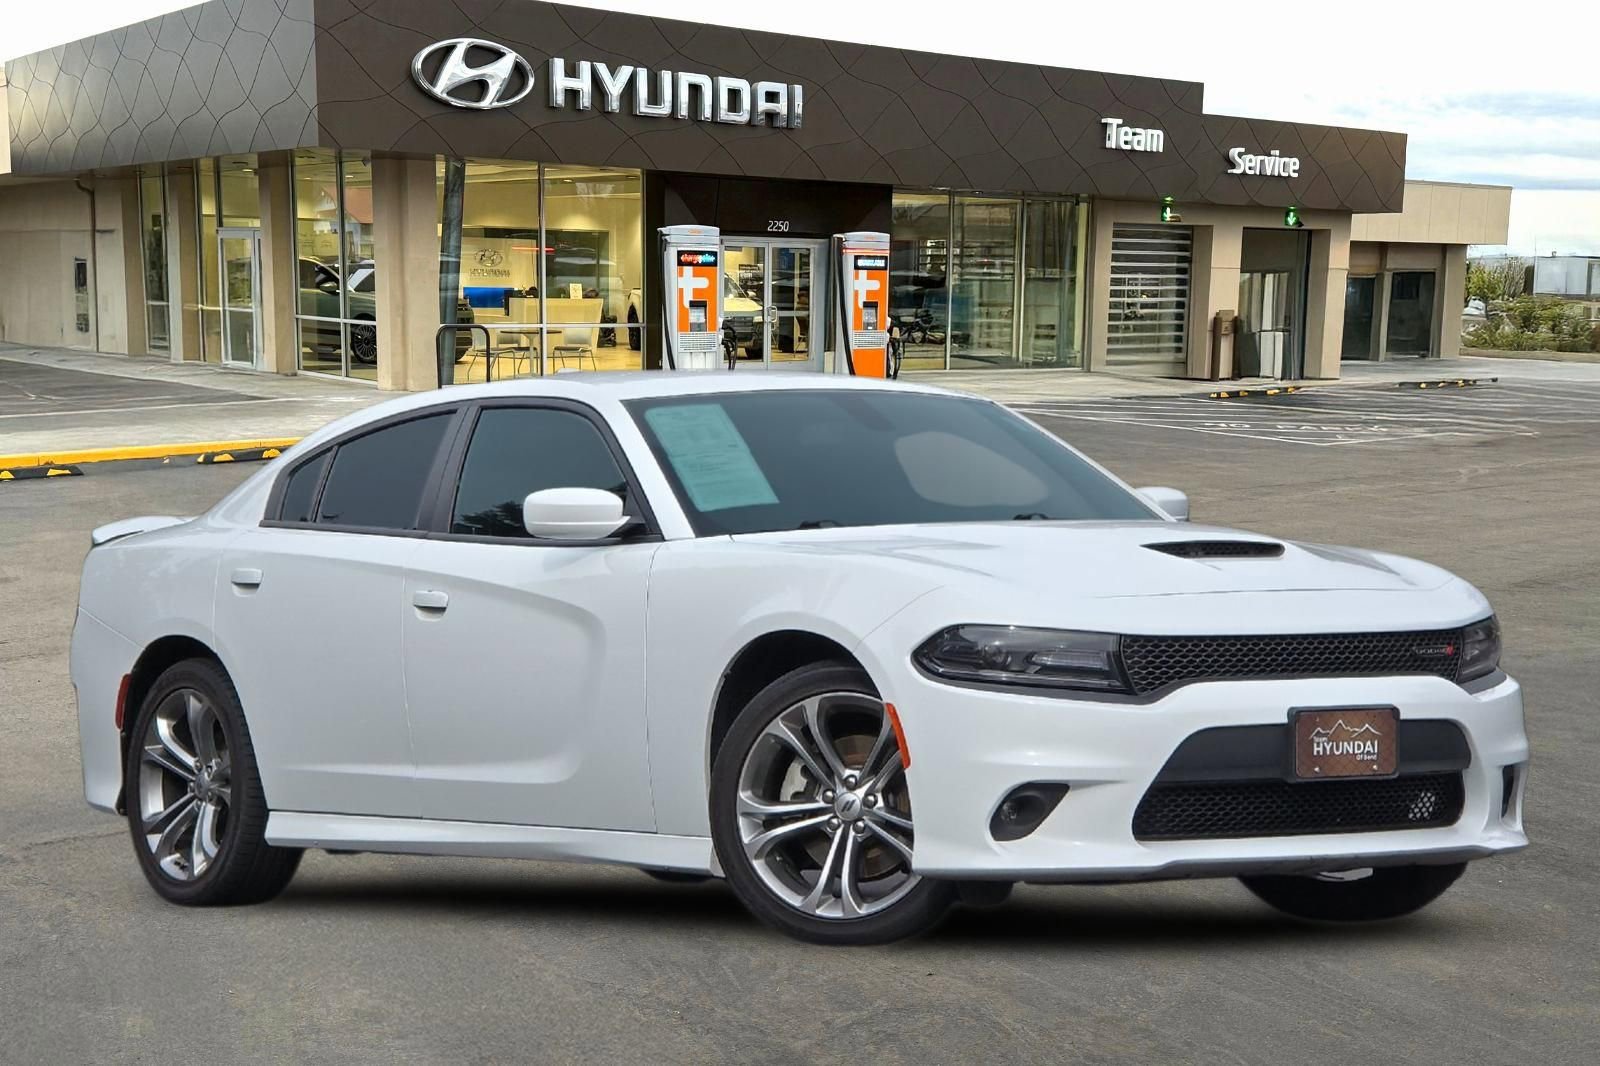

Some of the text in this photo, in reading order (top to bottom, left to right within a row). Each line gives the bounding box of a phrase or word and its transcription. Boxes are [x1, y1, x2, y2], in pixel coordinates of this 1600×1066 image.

[548, 57, 803, 129] HYUNDAI
[1101, 117, 1164, 153] Team
[1227, 147, 1300, 178] Service
[767, 220, 790, 232] 2250
[1313, 740, 1378, 756] HYUNDAI
